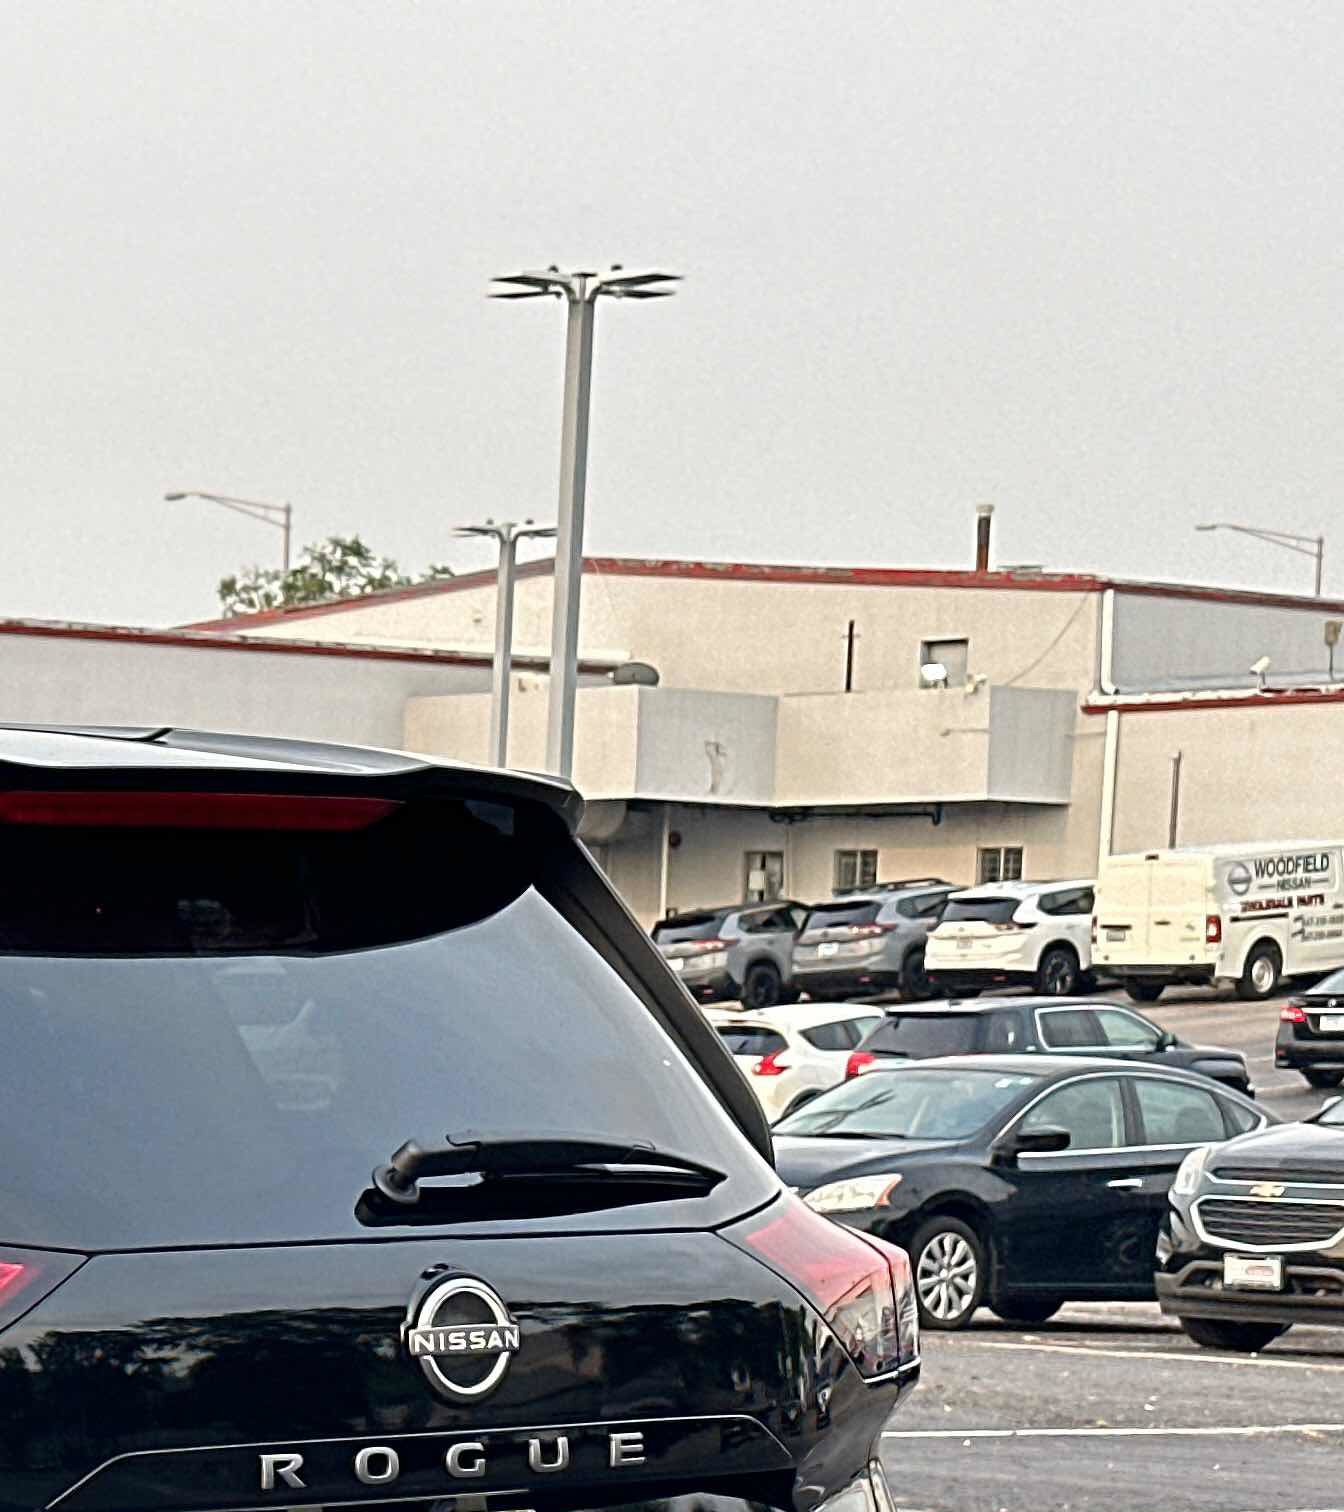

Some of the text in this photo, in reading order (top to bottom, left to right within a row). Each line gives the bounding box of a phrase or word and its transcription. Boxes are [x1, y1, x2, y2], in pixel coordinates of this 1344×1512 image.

[1254, 853, 1329, 878] WOODFIELD
[1277, 876, 1311, 891] NISSAN
[413, 1327, 520, 1353] NISSAN
[259, 1431, 646, 1490] ROGUE
